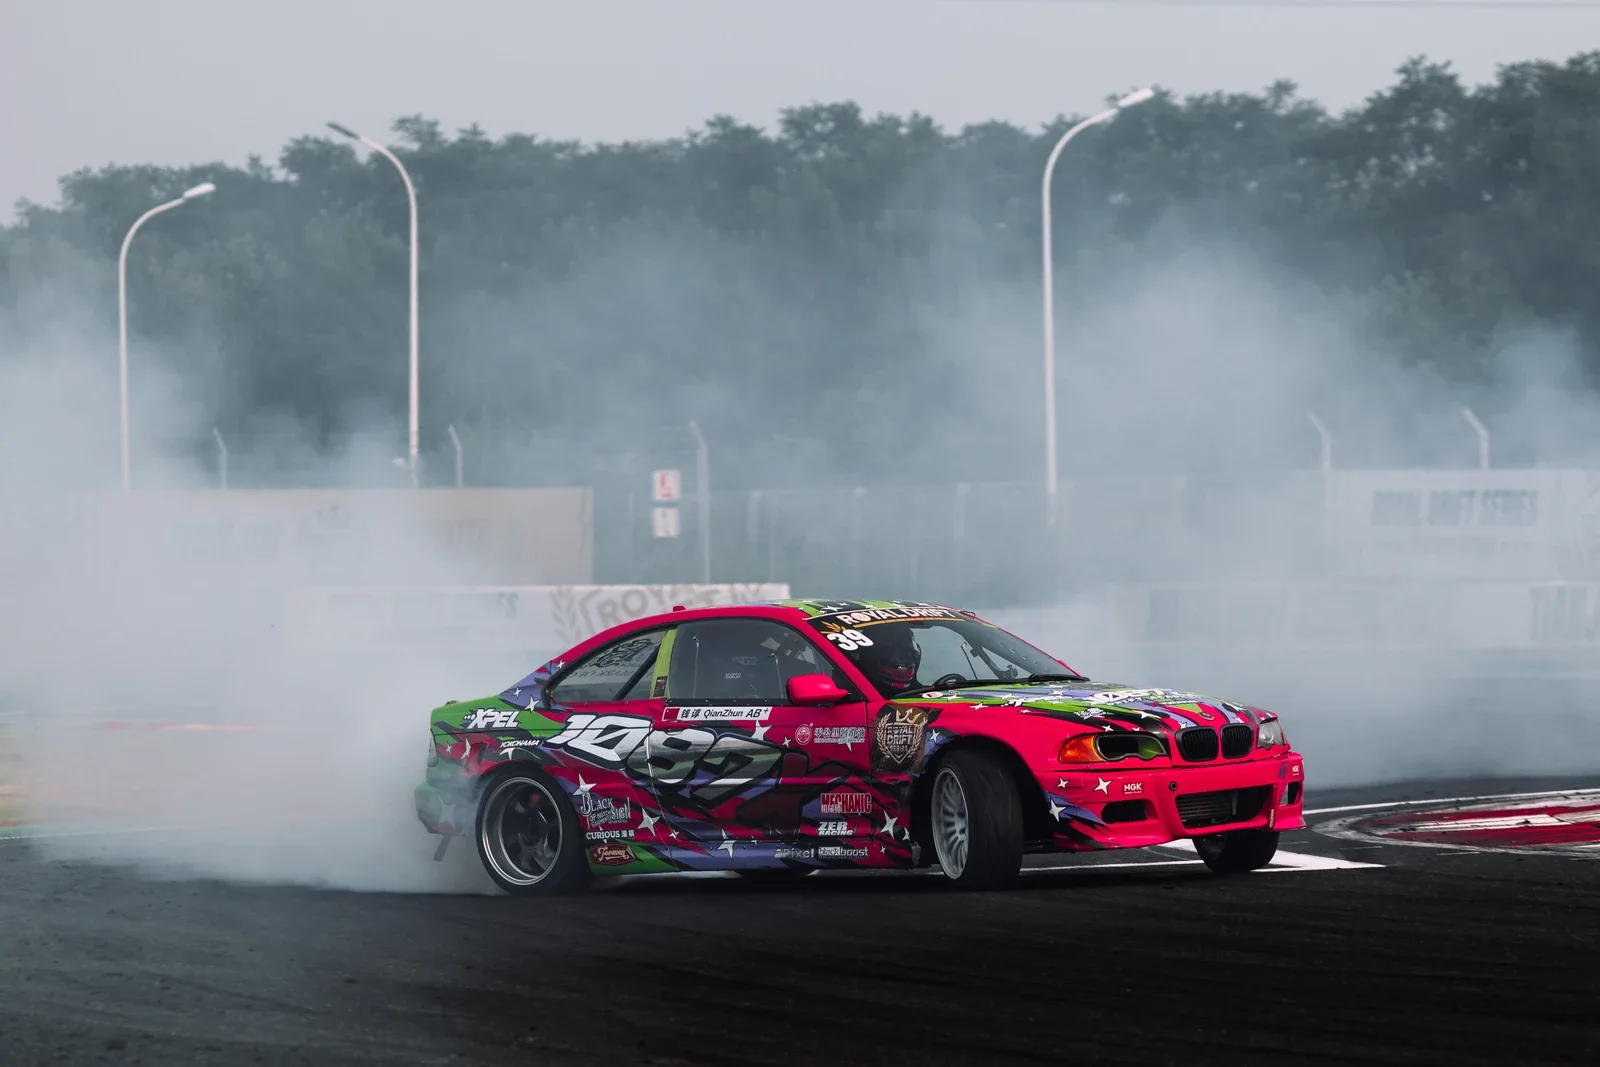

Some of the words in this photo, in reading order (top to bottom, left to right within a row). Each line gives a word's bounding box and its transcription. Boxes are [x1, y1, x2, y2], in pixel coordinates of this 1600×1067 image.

[836, 609, 908, 625] ROYAL
[904, 608, 956, 618] DRIFT
[827, 629, 874, 651] 39
[703, 709, 743, 718] QianZhun
[745, 708, 769, 718] AB+
[467, 708, 519, 729] XPEL
[887, 726, 912, 734] ROYAL
[500, 740, 539, 748] YOKOHAMA
[886, 735, 912, 745] DRIFT
[1124, 782, 1142, 792] NGK
[821, 793, 872, 814] MECHANIC
[586, 830, 620, 839] CURIOUS
